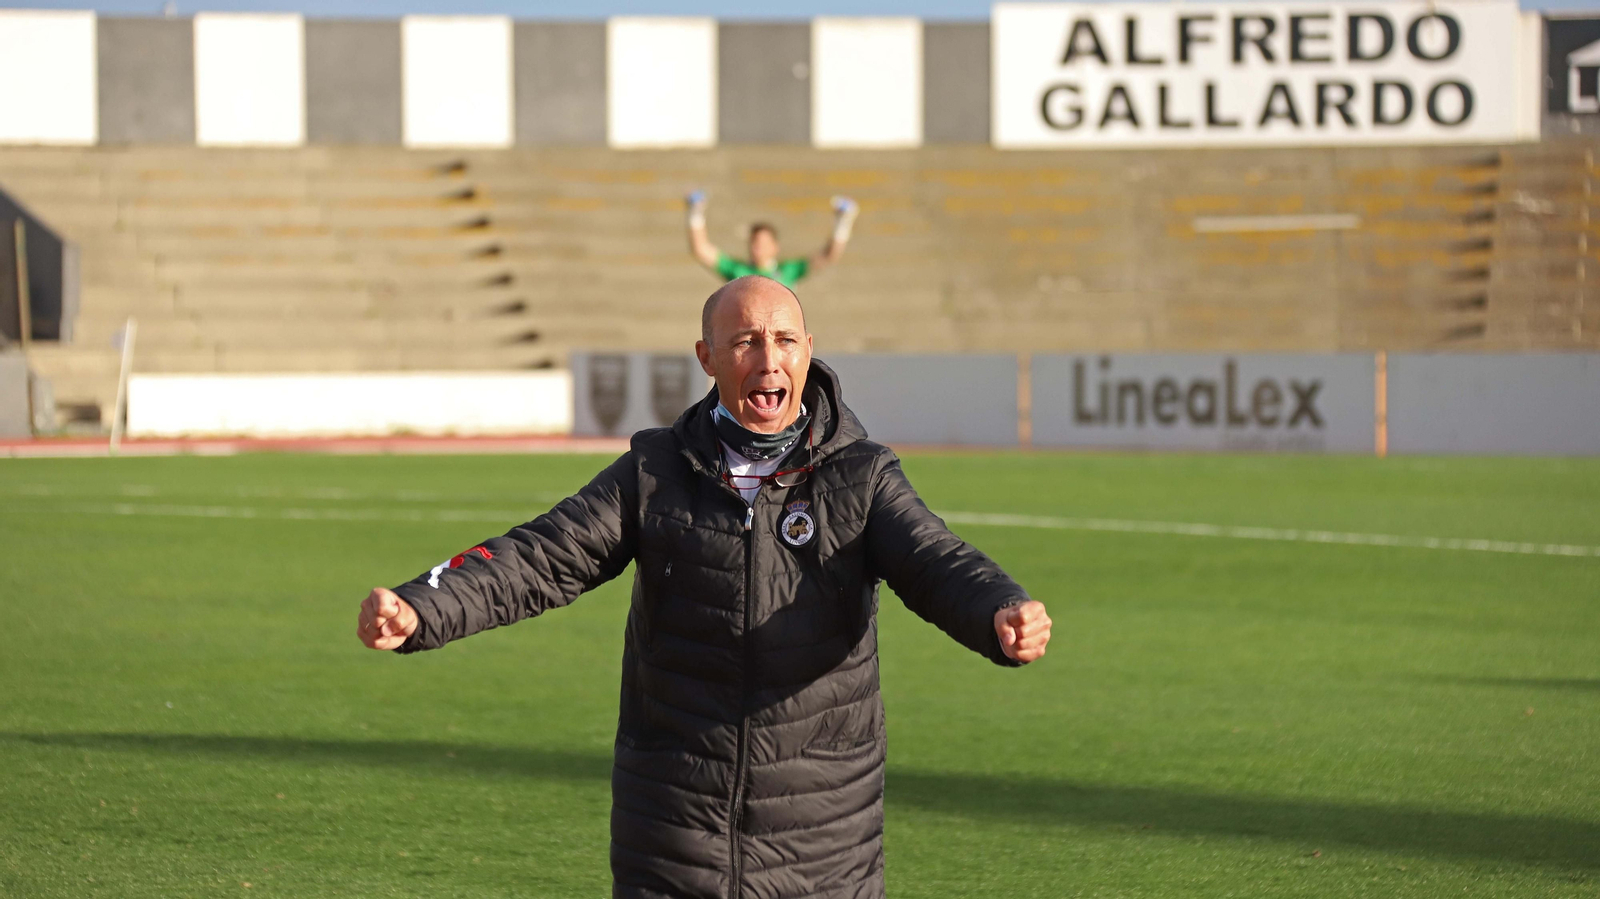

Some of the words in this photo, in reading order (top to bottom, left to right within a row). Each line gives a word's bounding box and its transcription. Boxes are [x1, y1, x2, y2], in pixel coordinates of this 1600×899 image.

[1061, 12, 1462, 66] ALFREDO
[1040, 80, 1475, 129] GALLARDO
[1071, 355, 1325, 429] LineaLex
